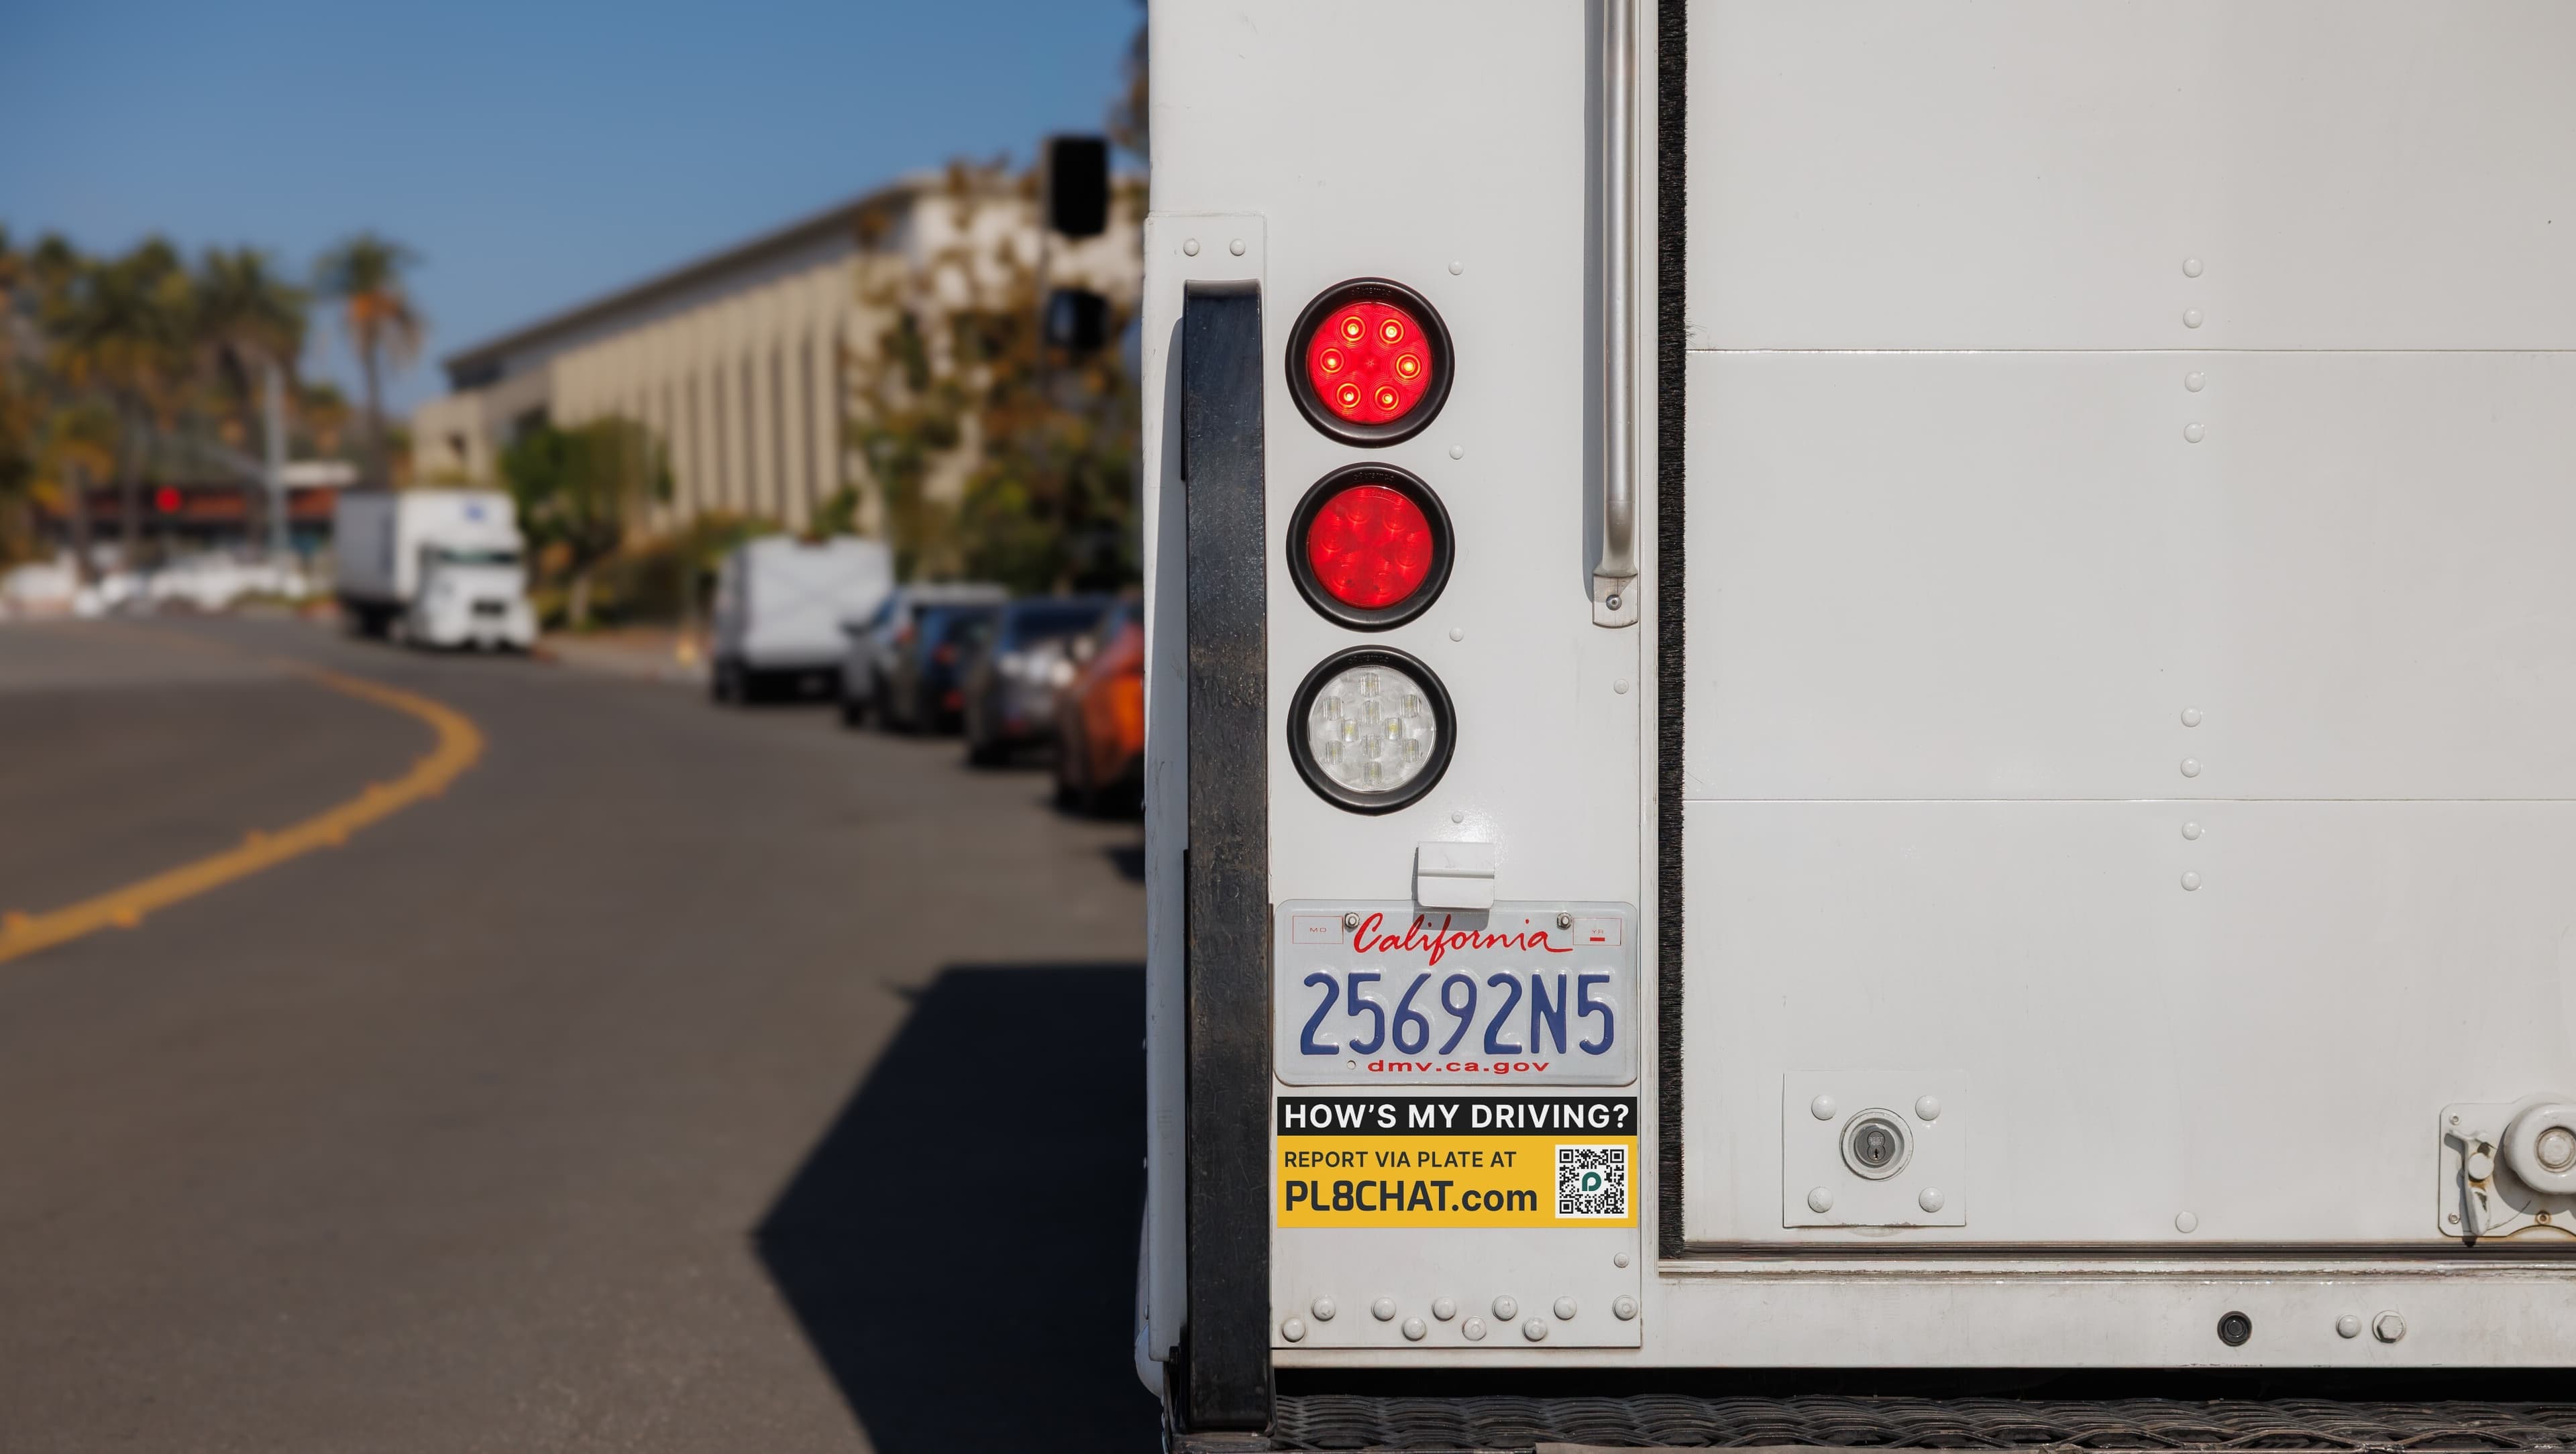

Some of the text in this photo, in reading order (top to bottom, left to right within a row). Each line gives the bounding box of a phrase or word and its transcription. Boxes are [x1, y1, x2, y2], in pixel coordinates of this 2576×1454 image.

[1353, 912, 1573, 966] California
[1301, 973, 1614, 1055] 25692N5
[1367, 1060, 1549, 1074] dmv.ca.gov
[1285, 1104, 1629, 1128] HOW’S MY DRIVING?
[1285, 1152, 1516, 1167] REPORT VIA PLATE AT
[1286, 1180, 1537, 1211] PL8CHAT.com
